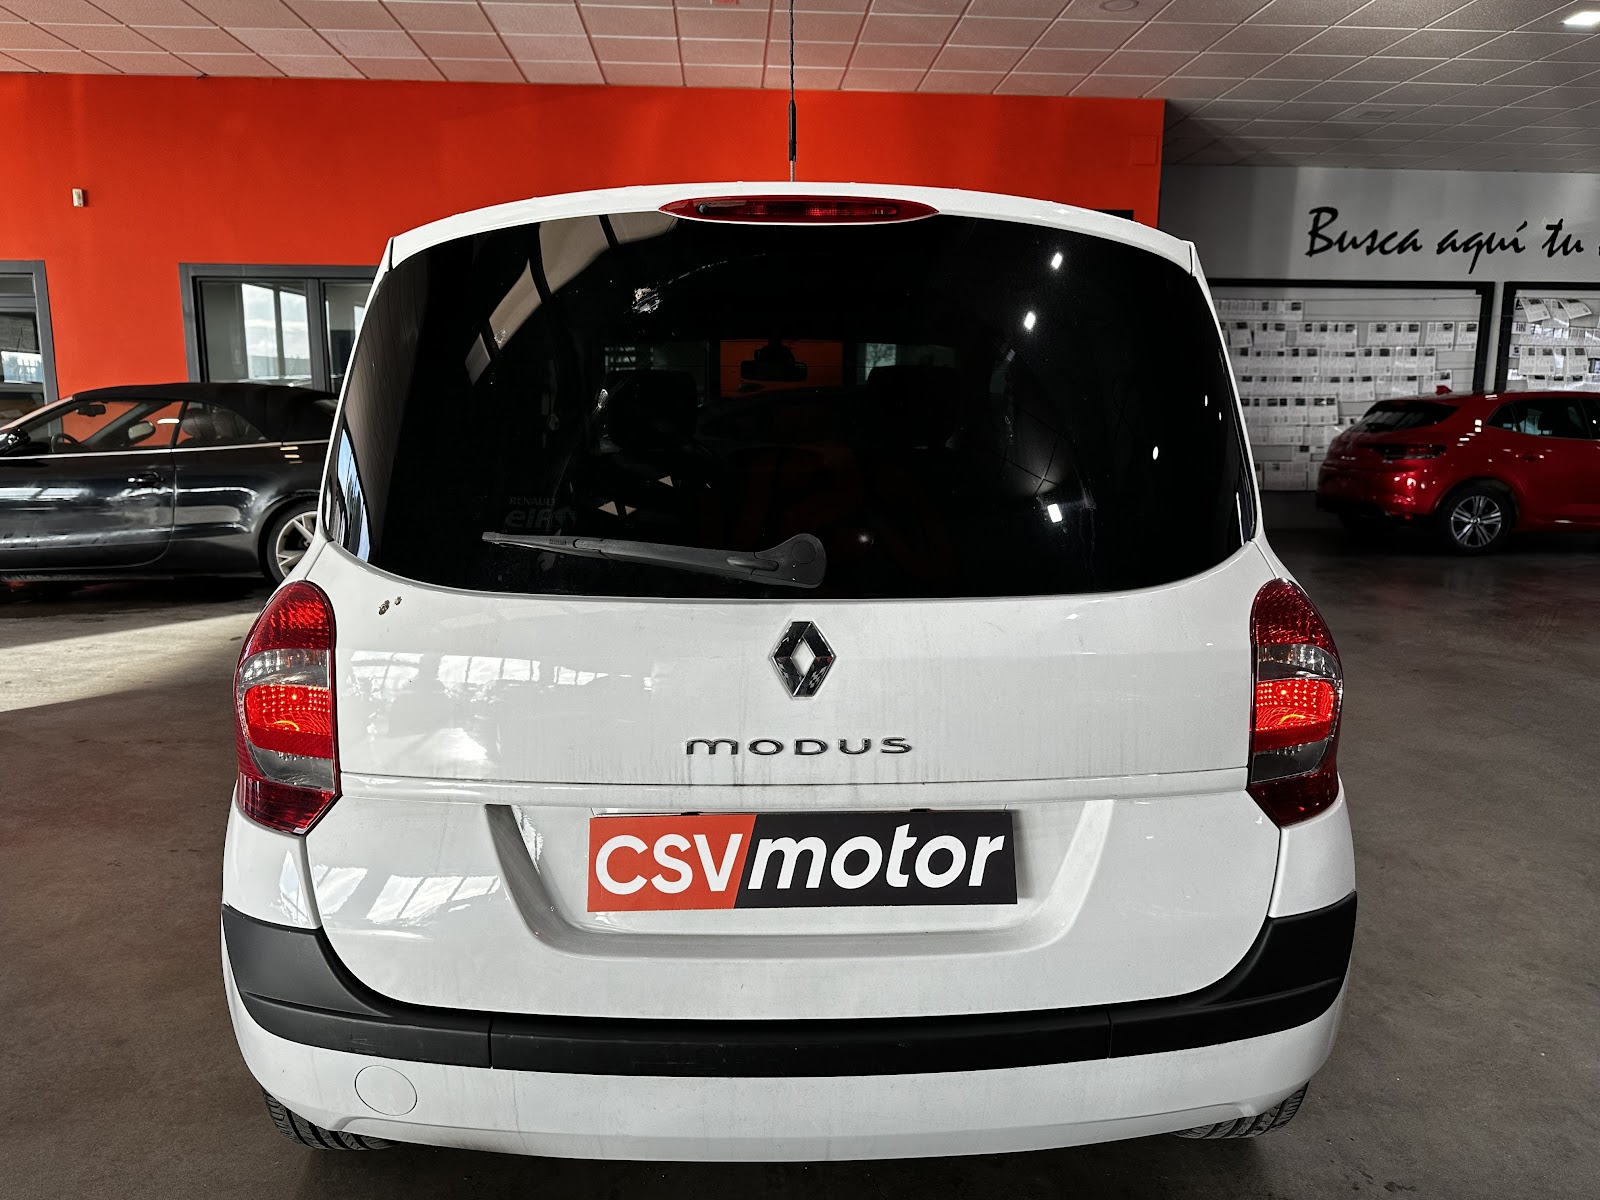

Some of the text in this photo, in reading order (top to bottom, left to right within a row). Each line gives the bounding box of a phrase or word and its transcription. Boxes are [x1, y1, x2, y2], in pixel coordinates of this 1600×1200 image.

[1305, 206, 1584, 274] Busca aquí tu
[509, 497, 556, 506] RENAULT
[595, 823, 1005, 895] CSVmotor
